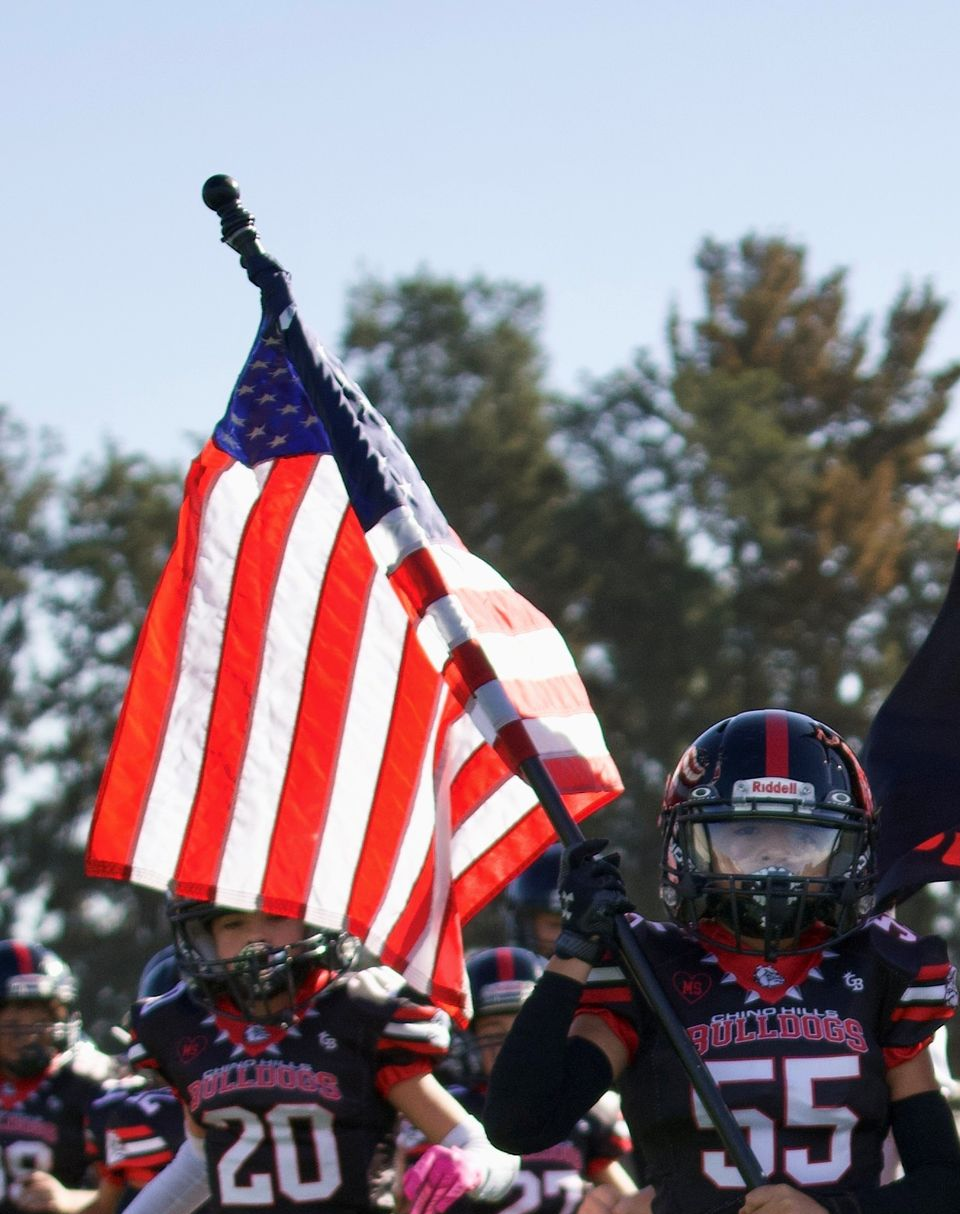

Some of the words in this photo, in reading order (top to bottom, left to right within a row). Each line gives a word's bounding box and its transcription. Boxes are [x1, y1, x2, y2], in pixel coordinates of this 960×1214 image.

[752, 781, 797, 795] Riddell
[686, 1013, 869, 1055] BULLDOGS
[711, 1007, 777, 1024] CHINO
[781, 1006, 838, 1018] HILLS
[187, 1065, 342, 1112] BULLDOGS
[690, 1053, 862, 1190] 55
[202, 1103, 343, 1207] 20
